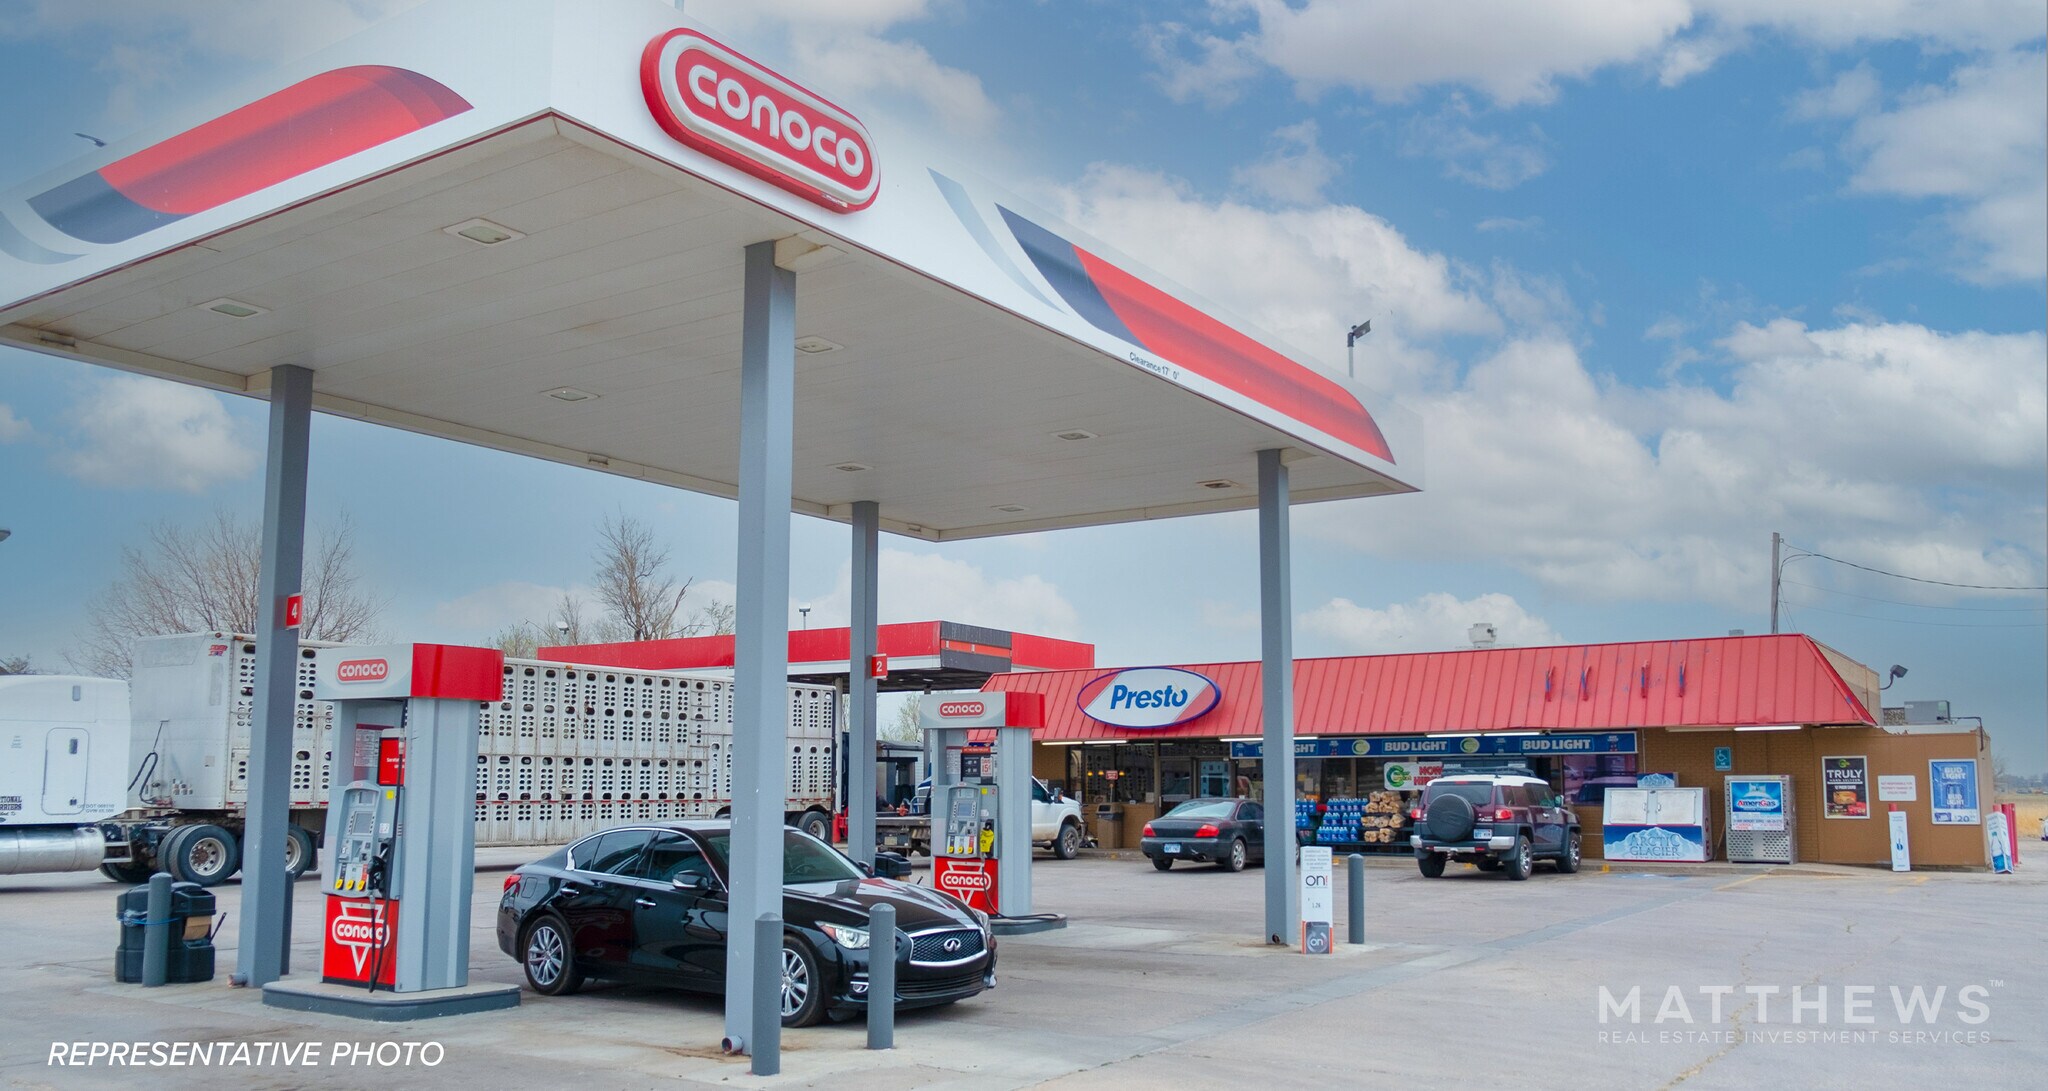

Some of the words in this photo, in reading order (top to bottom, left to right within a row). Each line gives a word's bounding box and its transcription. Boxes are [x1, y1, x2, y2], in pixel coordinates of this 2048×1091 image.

[1129, 352, 1161, 373] Clearance
[291, 603, 298, 619] 4
[876, 660, 883, 673] 2
[1110, 684, 1188, 710] Presto
[1384, 742, 1410, 751] BUD
[1411, 740, 1448, 751] LIGHT
[1522, 740, 1550, 750] BUD
[1552, 739, 1591, 749] LIGHT
[1826, 769, 1863, 779] TRULY
[1629, 834, 1681, 847] ARCTIC
[1629, 846, 1680, 857] GLACIER
